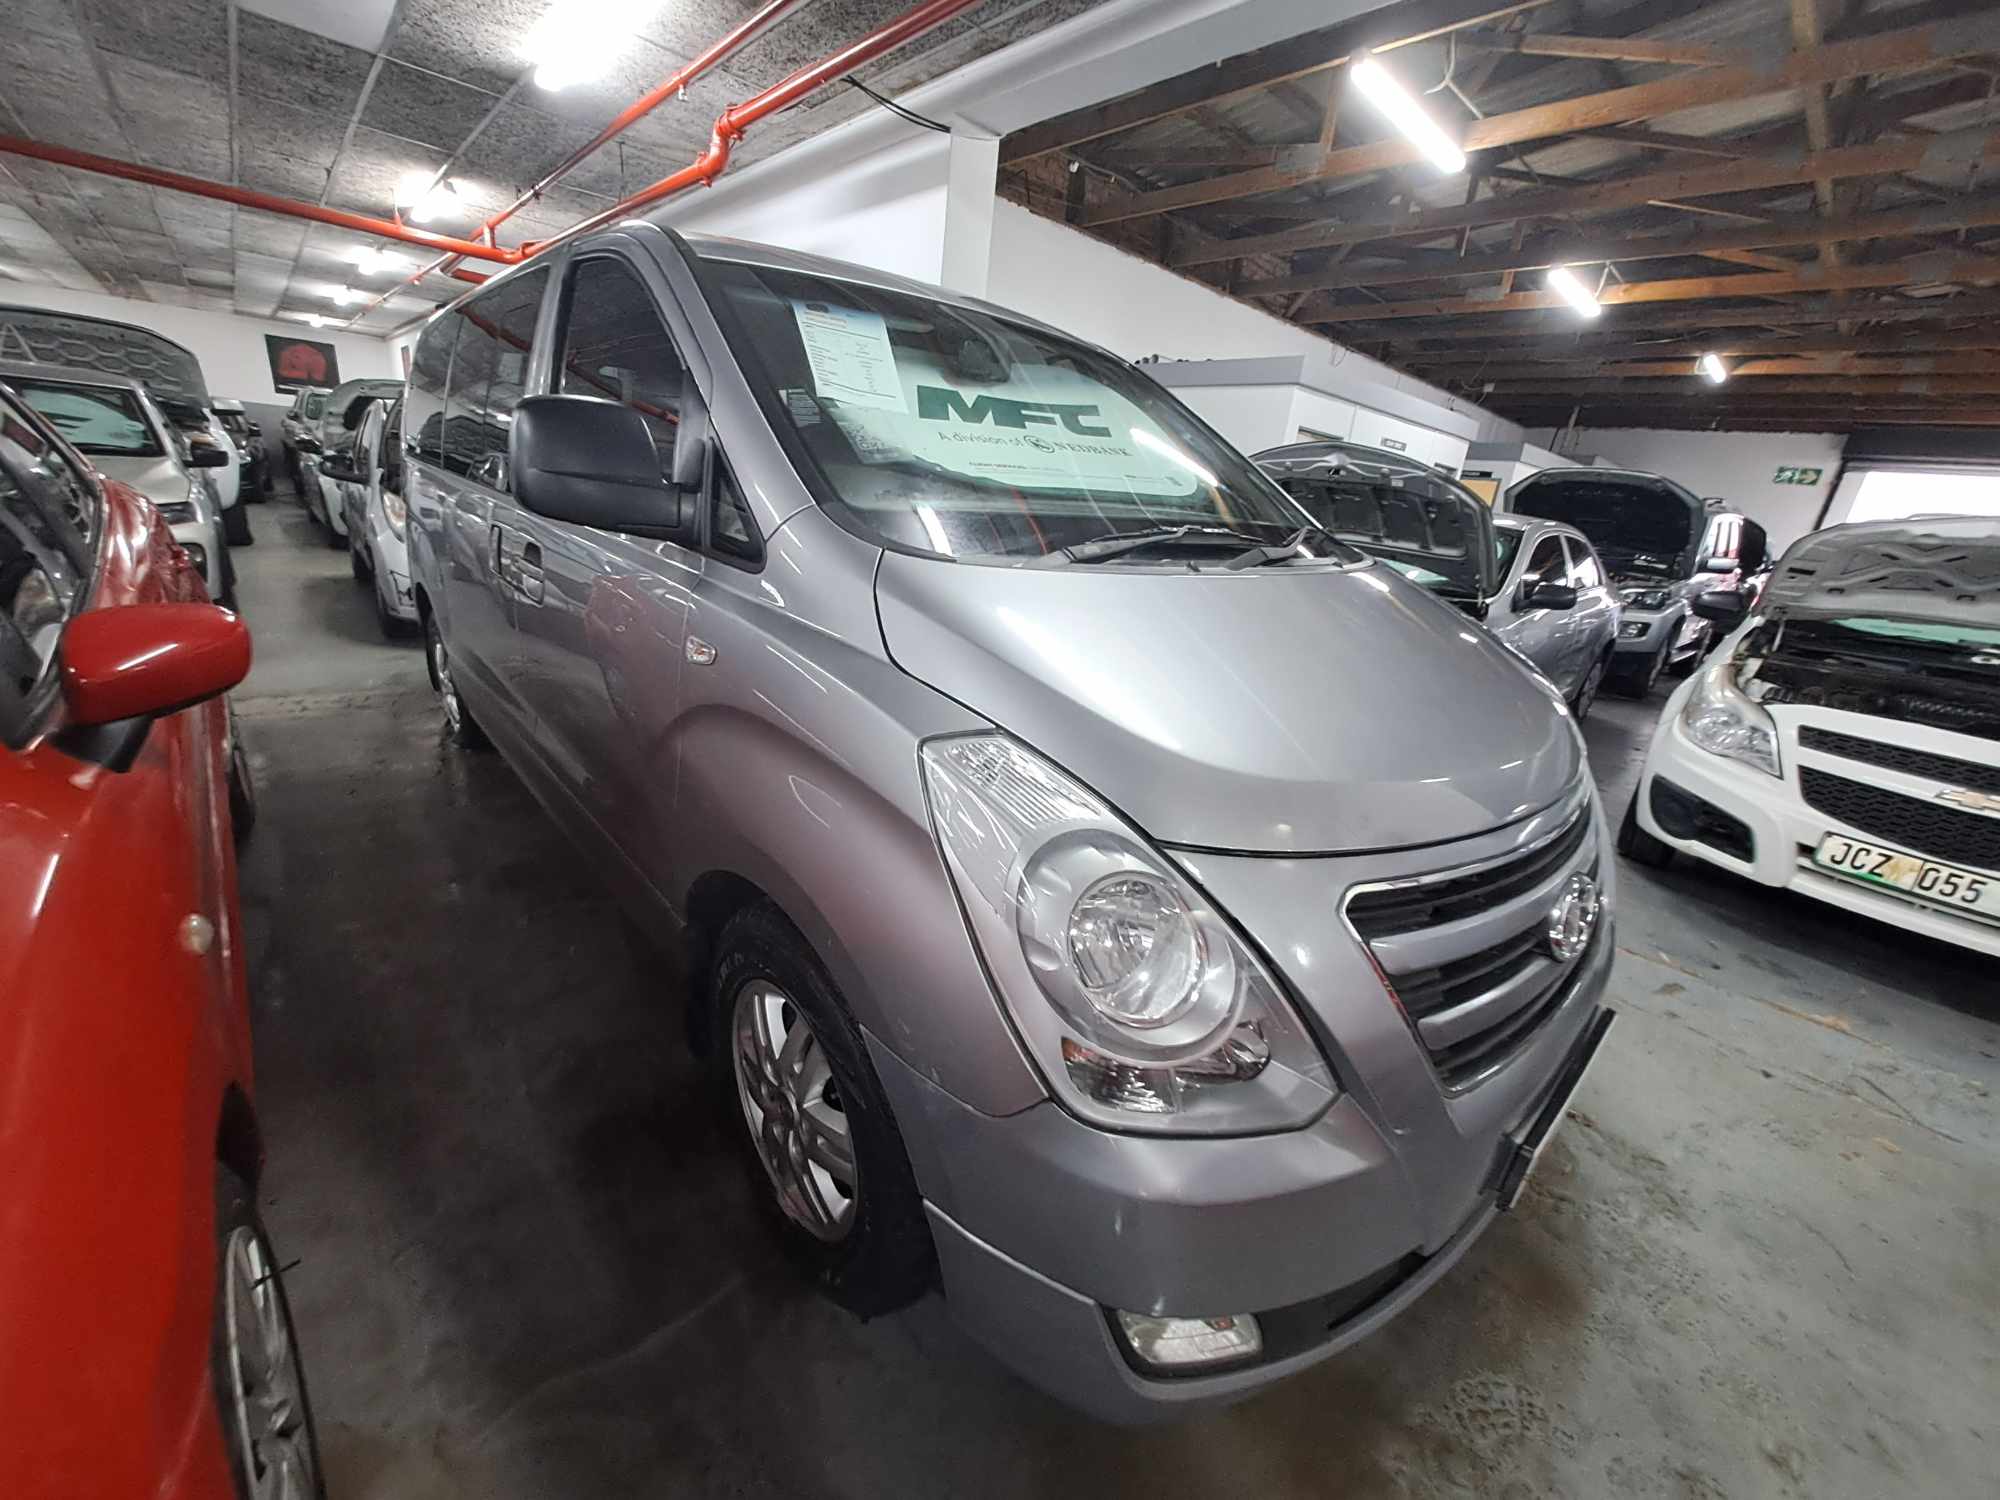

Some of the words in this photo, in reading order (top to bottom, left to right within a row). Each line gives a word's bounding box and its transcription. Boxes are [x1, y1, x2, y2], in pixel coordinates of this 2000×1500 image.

[917, 385, 1112, 437] MFC
[938, 431, 950, 441] A
[952, 431, 1005, 446] division
[1008, 436, 1024, 447] of
[1054, 441, 1134, 457] NEDBANK
[1829, 842, 1894, 878] JCZ
[1917, 867, 1988, 903] 055
